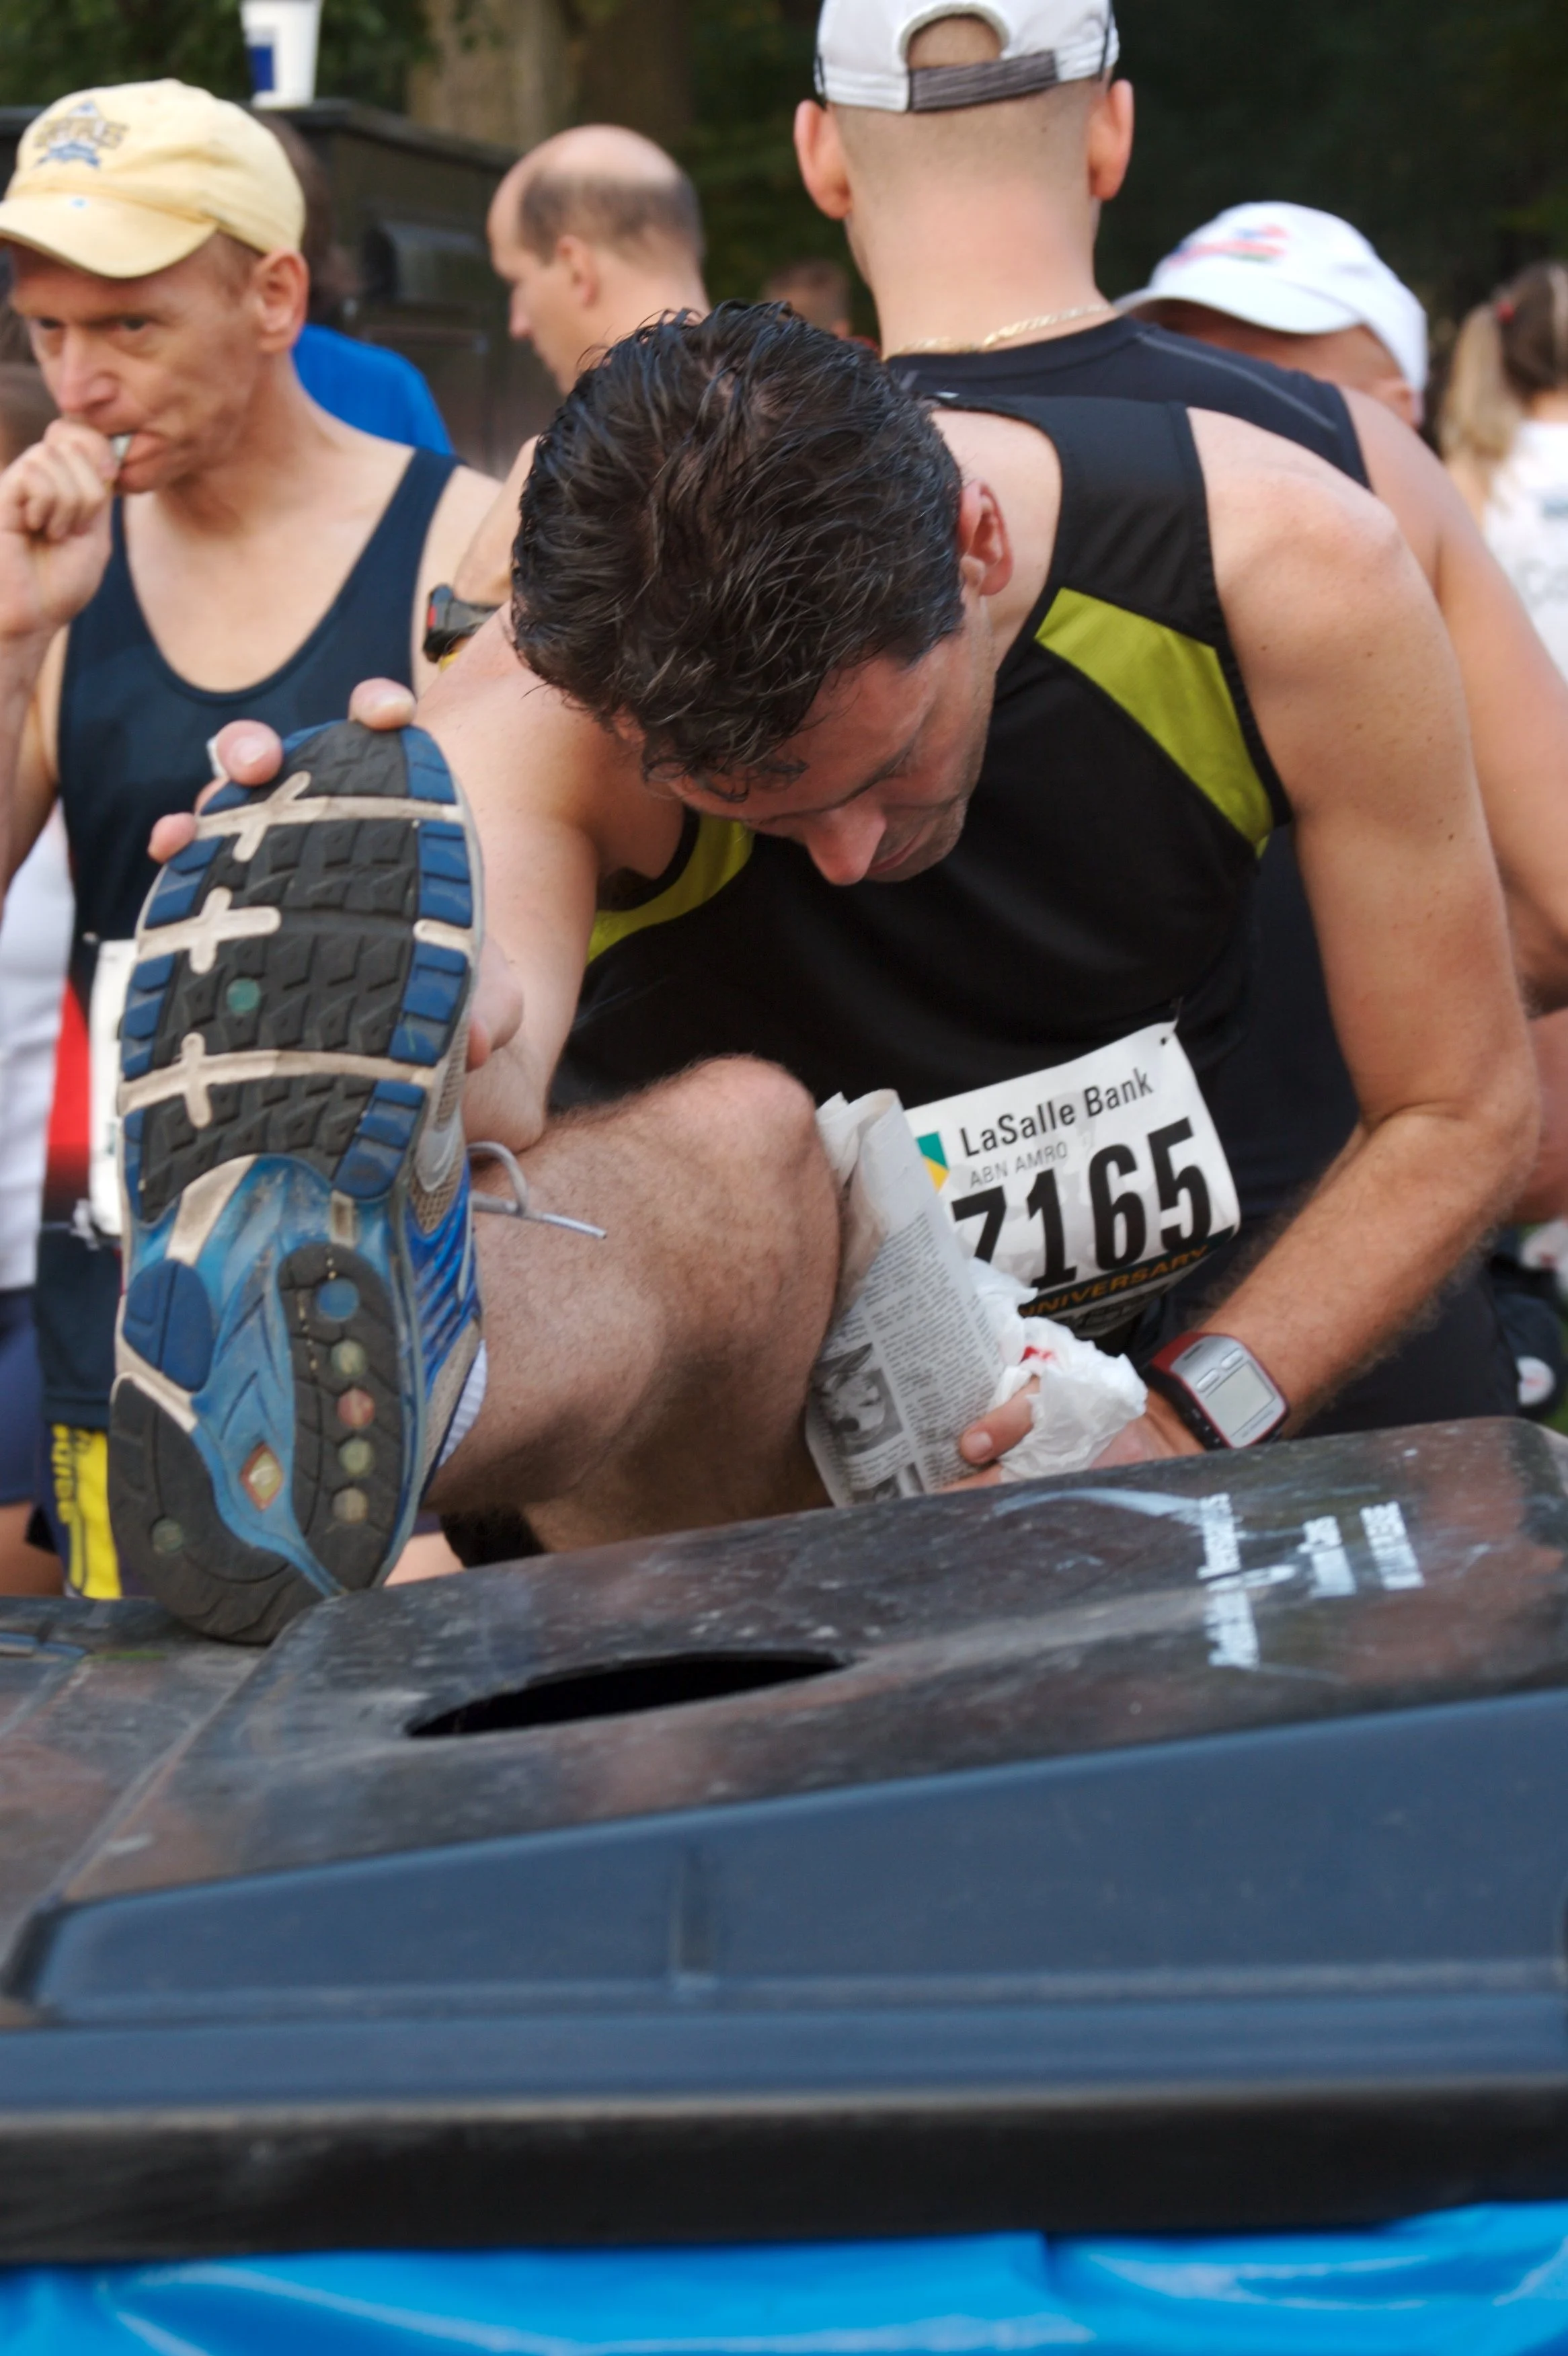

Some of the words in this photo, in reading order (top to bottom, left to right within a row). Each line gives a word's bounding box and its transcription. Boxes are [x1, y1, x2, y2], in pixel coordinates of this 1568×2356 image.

[959, 1100, 1076, 1158] LaSalle
[1083, 1067, 1154, 1117] Bank
[951, 1116, 1211, 1289] 7165
[969, 1161, 1009, 1189] ABN
[1014, 1141, 1068, 1173] AMRO
